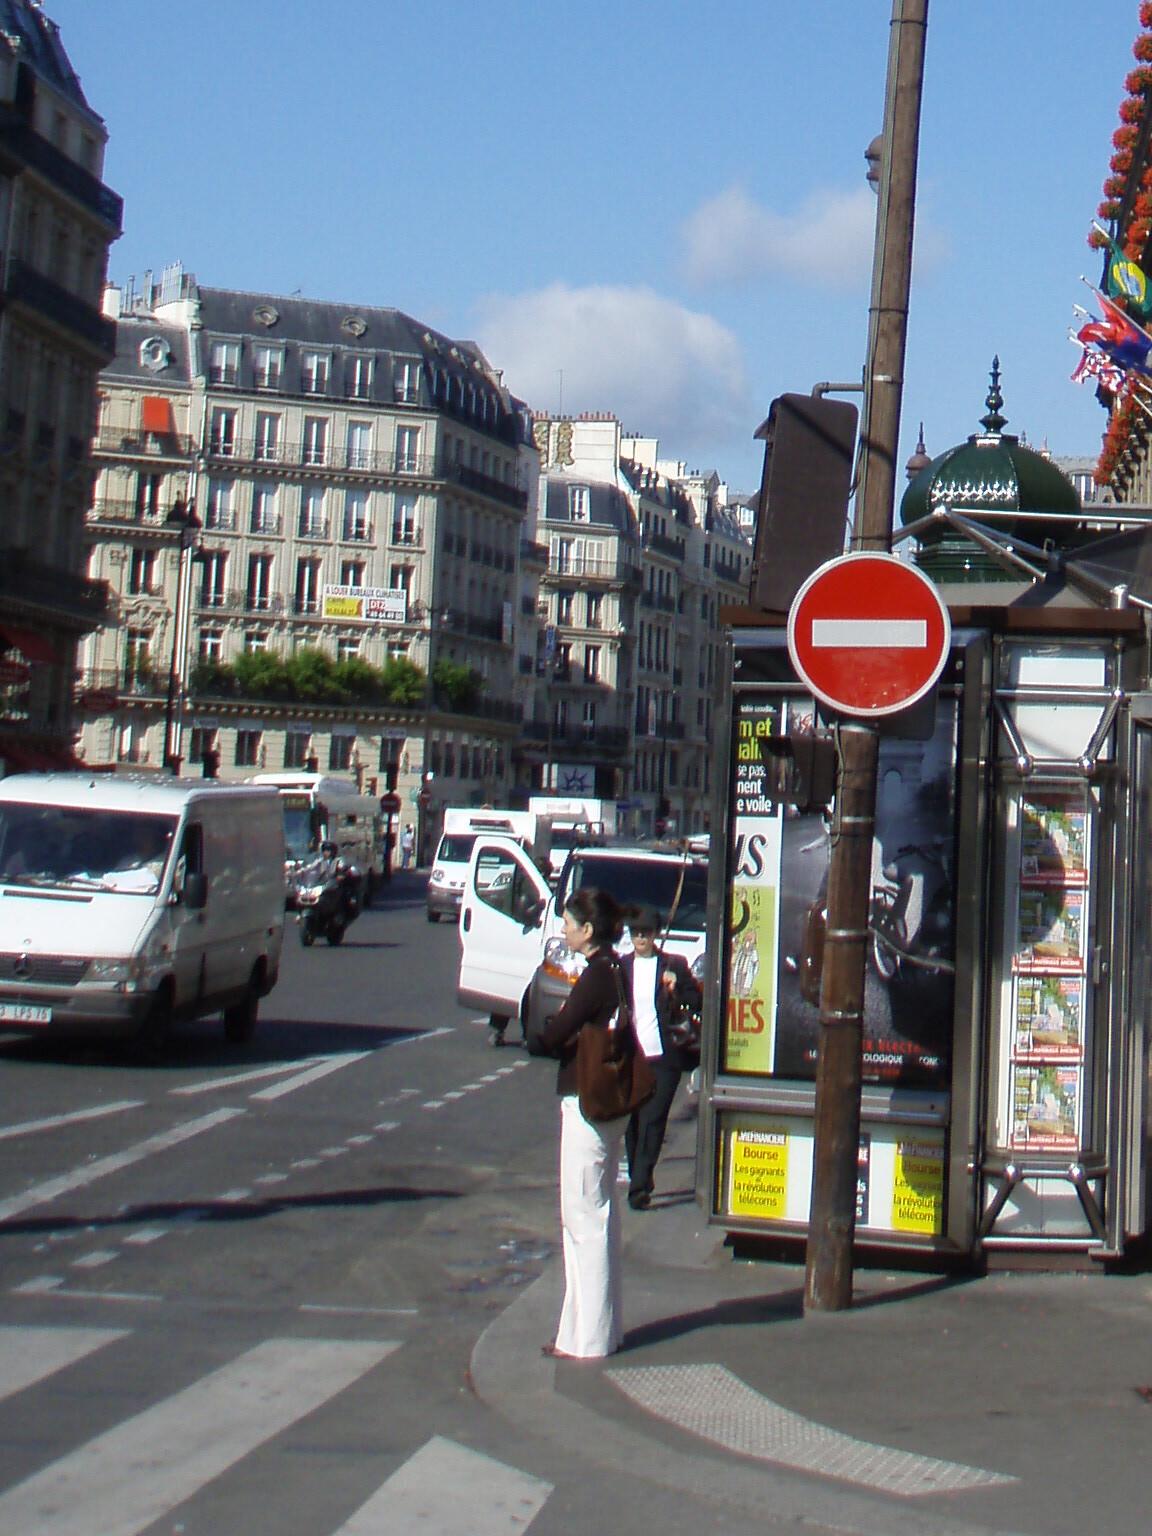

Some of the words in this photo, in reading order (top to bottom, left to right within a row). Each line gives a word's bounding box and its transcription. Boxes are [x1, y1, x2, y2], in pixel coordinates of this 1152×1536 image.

[756, 717, 772, 736] et
[737, 779, 762, 794] nent
[737, 798, 744, 811] e
[746, 795, 772, 812] voile
[743, 1147, 779, 1160] Bourse
[734, 1163, 748, 1174] Les
[750, 1165, 785, 1177] gagnants
[742, 1181, 785, 1194] révolution
[739, 1193, 777, 1206] télécoms
